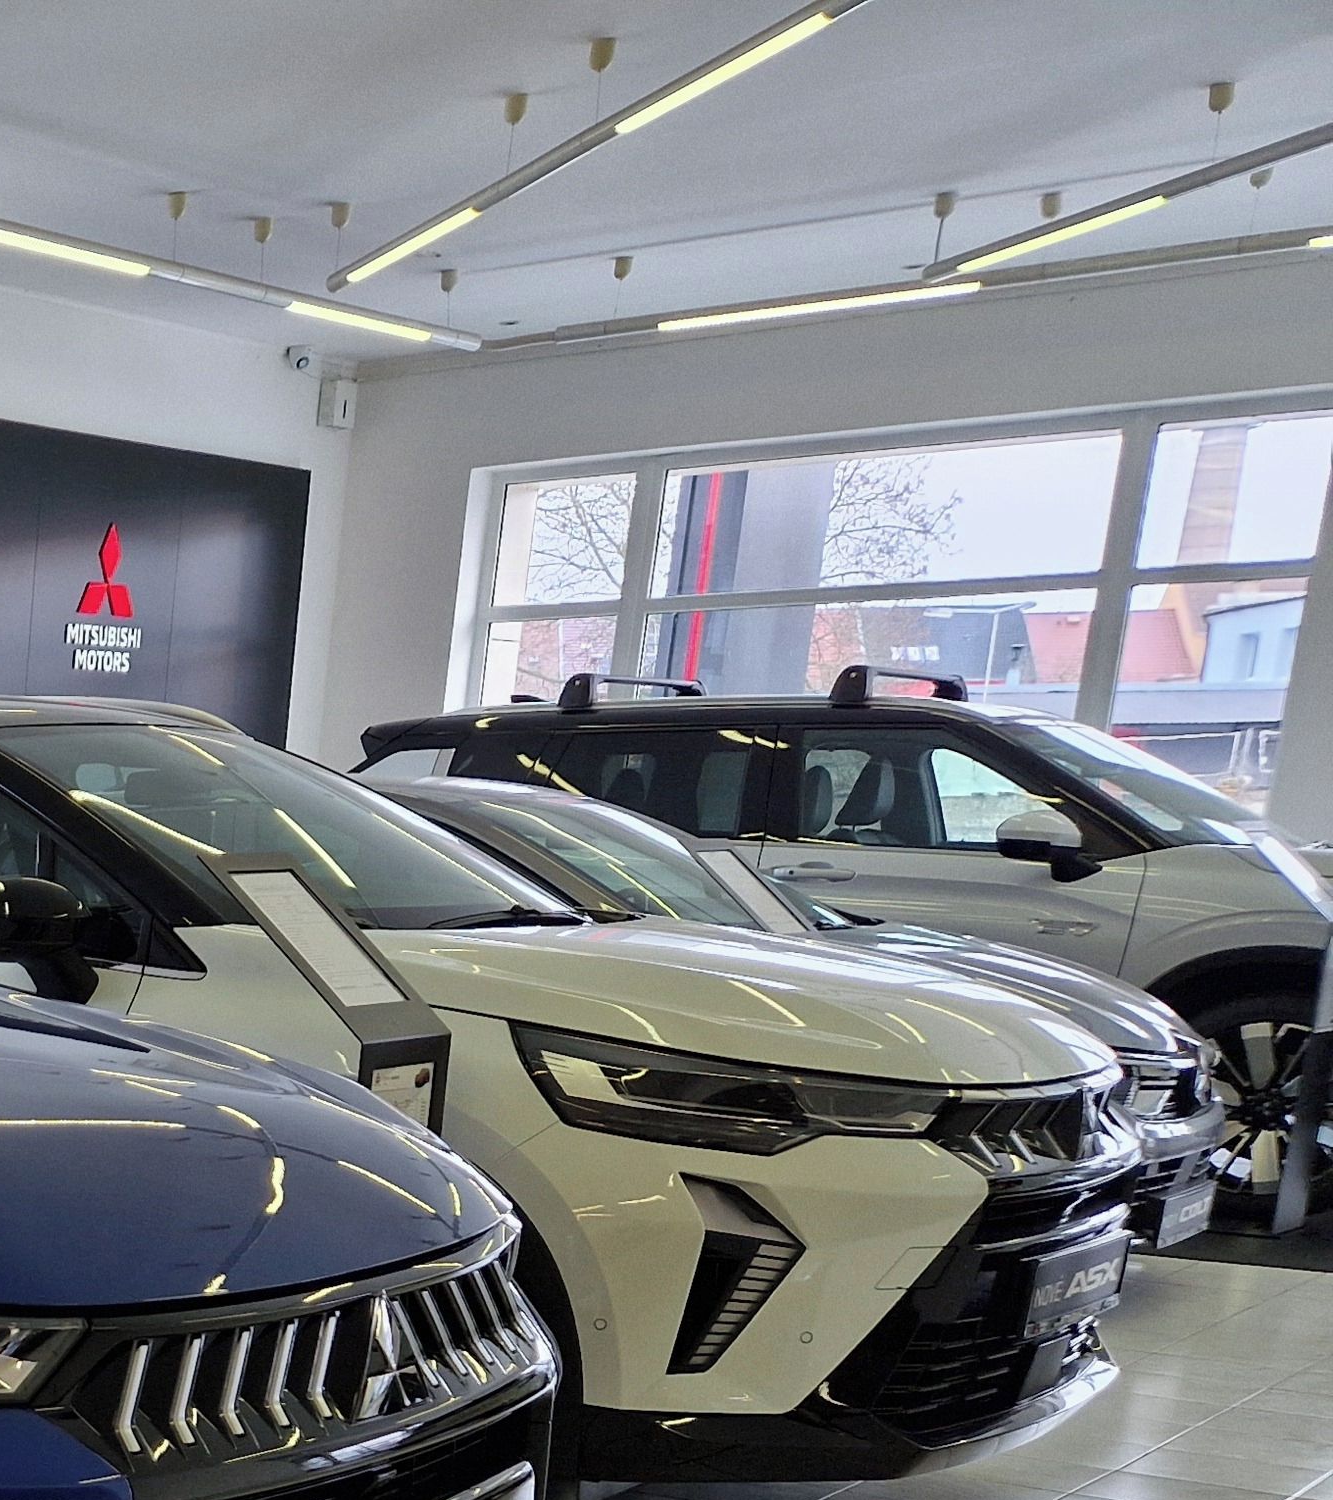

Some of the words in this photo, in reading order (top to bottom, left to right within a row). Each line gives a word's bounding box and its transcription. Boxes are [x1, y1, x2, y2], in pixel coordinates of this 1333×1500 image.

[65, 623, 142, 649] MITSUBISHI
[73, 649, 131, 673] MOTORS
[1064, 1257, 1121, 1299] ASX
